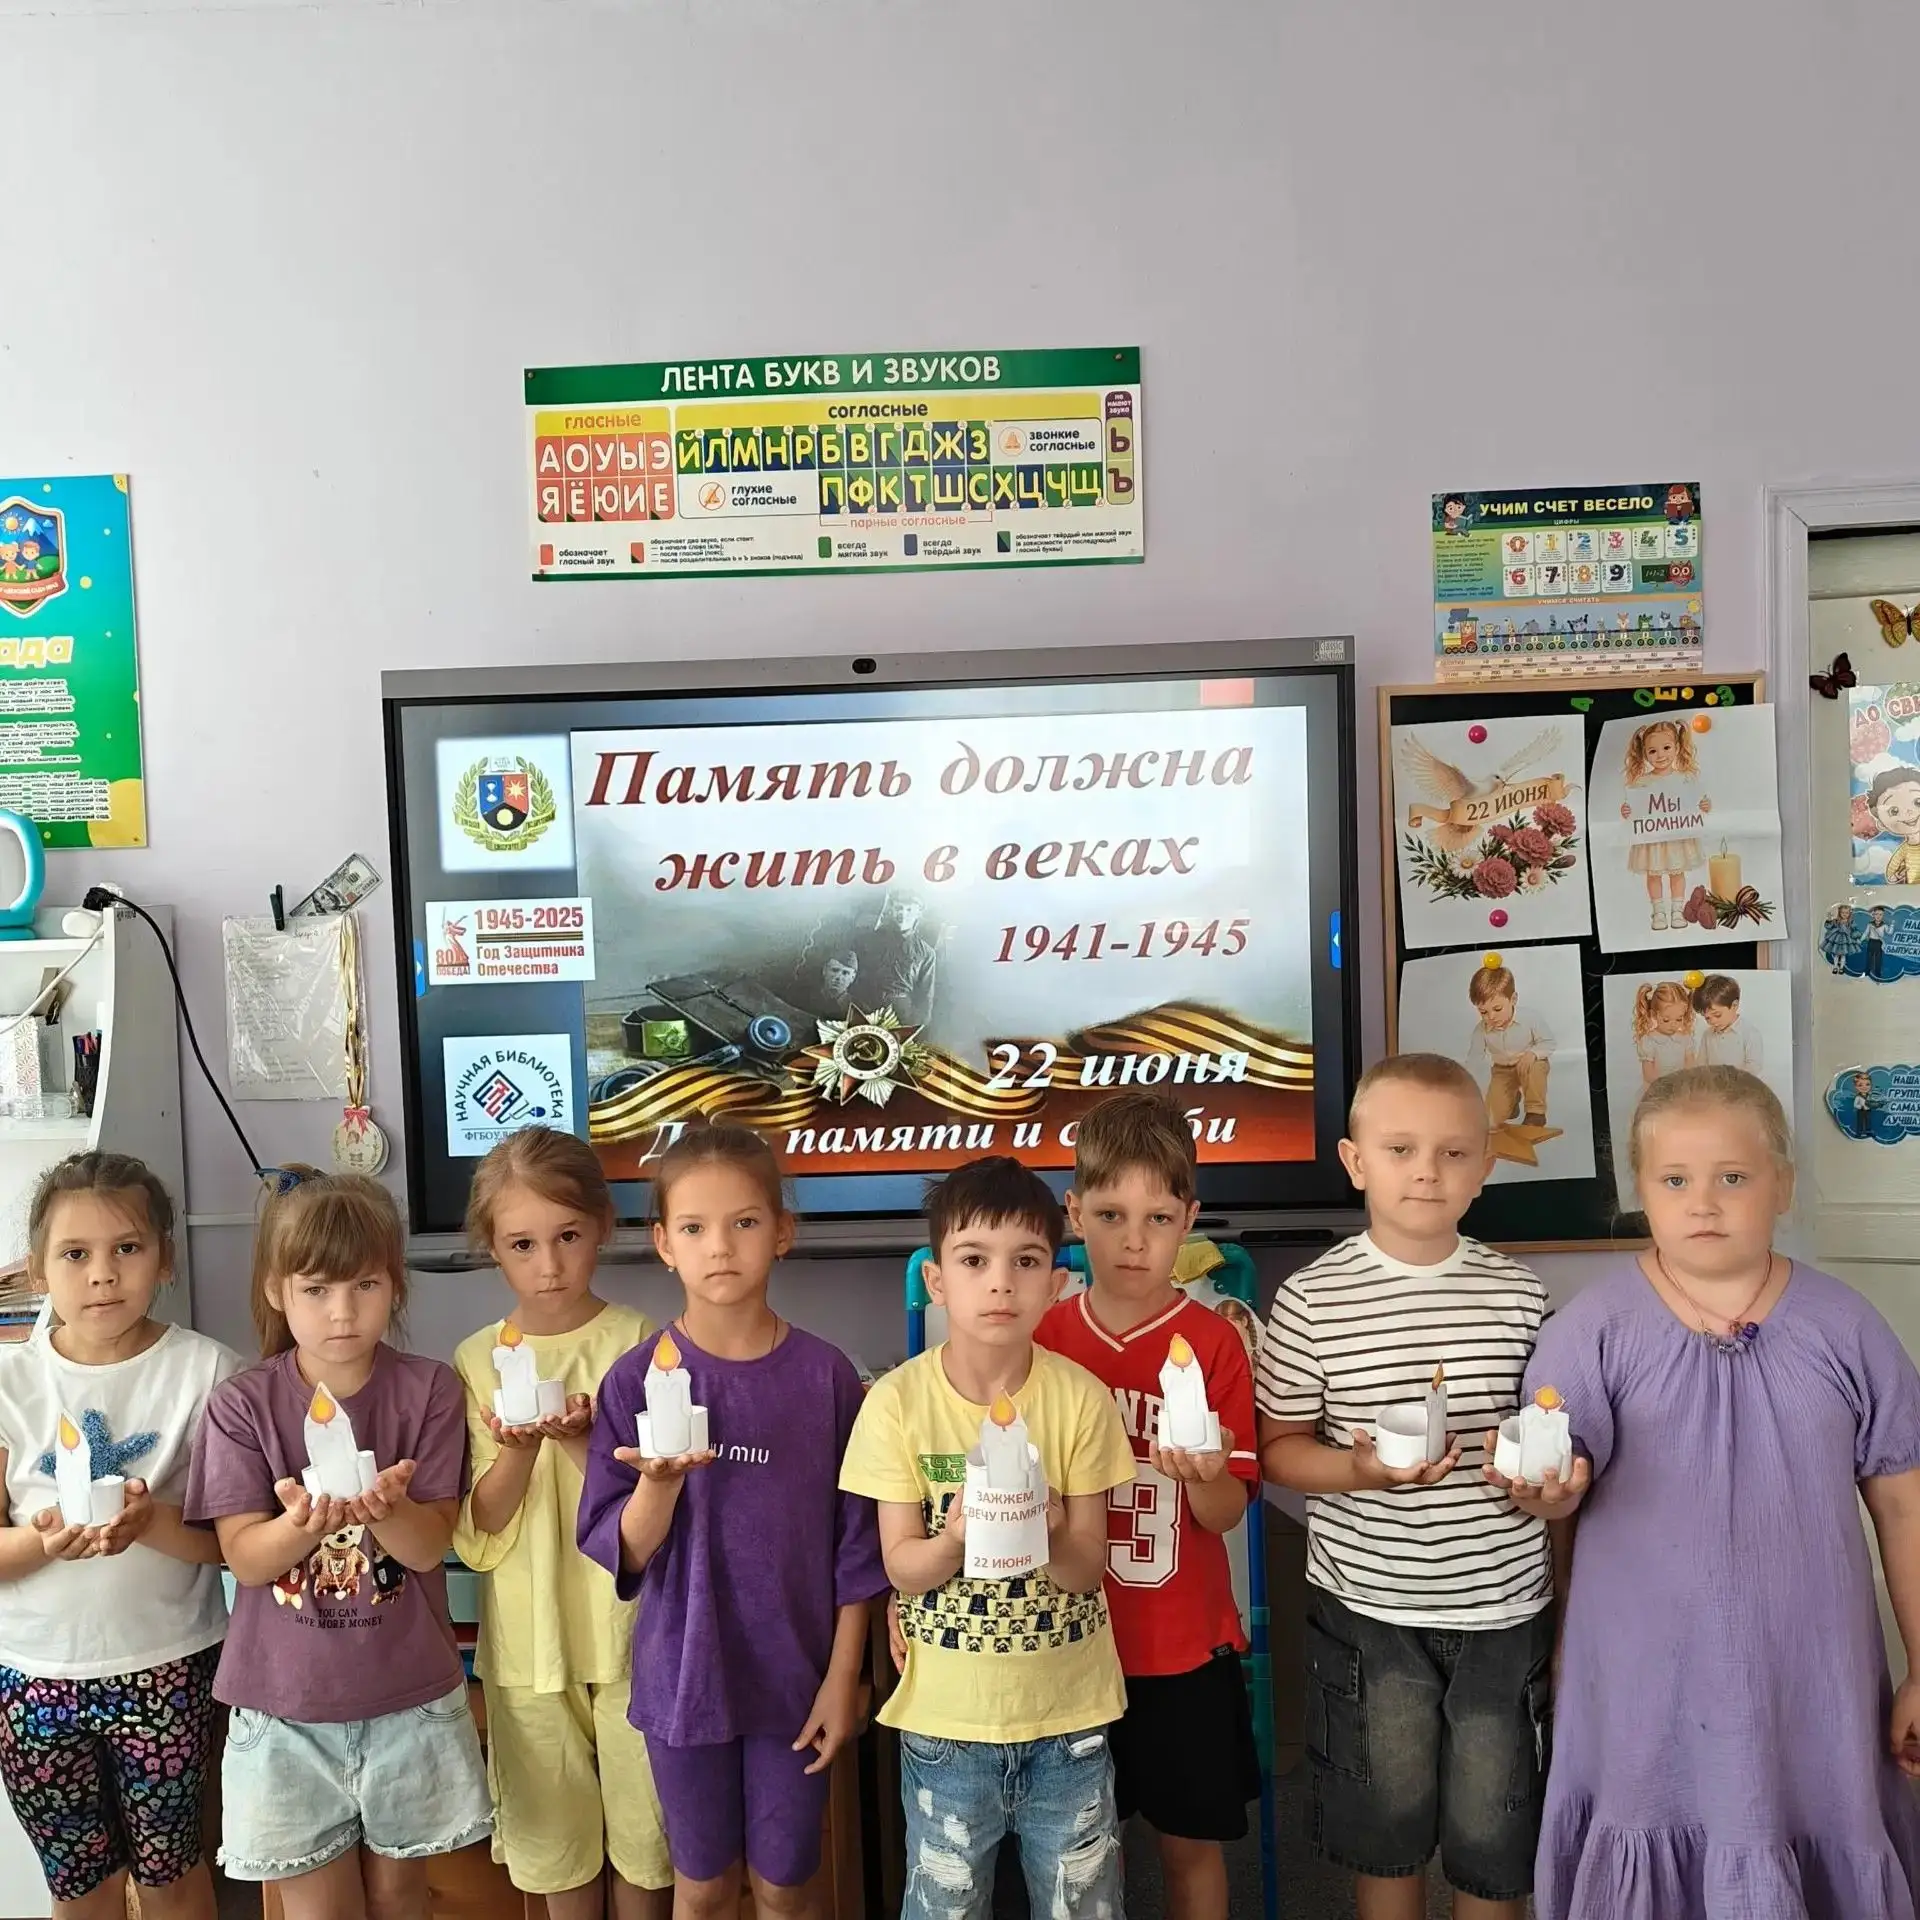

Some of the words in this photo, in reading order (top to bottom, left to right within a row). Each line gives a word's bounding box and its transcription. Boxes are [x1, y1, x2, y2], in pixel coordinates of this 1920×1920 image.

[661, 363, 754, 392] ЛЕНТА
[765, 360, 841, 387] БУКВ
[852, 360, 872, 384] И
[884, 356, 1000, 384] ЗВУКОВ
[829, 402, 928, 418] согласные
[565, 411, 642, 430] гласные
[1029, 430, 1080, 440] звонкие
[1030, 441, 1096, 452] согласные
[732, 484, 773, 495] глухие
[732, 494, 797, 506] согласные
[1479, 502, 1528, 517] УЧИМ
[1533, 500, 1579, 514] СЧЕТ
[1583, 496, 1654, 512] ВЕСЕЛО
[850, 517, 897, 529] парные
[901, 516, 966, 527] согласные
[559, 549, 608, 557] обозначает
[837, 542, 867, 550] всегда
[838, 549, 867, 558] мягкий
[870, 550, 888, 558] звук
[963, 548, 981, 556] звук
[559, 557, 594, 565] гласный
[597, 558, 615, 566] звук
[1856, 706, 1880, 728] ДО
[585, 750, 911, 807] Память
[940, 741, 1254, 795] должна
[1467, 801, 1490, 821] 22
[1497, 784, 1549, 812] ИЮНЯ
[1648, 793, 1681, 814] Мы
[655, 846, 895, 892] жить
[924, 844, 959, 883] в
[985, 835, 1199, 881] веках
[474, 907, 584, 930] 1945-2025
[993, 918, 1250, 964] 1941-1945
[476, 946, 501, 960] Год
[504, 945, 585, 959] Защитника
[477, 963, 559, 977] Отечества
[985, 1042, 1059, 1089] 22
[1079, 1051, 1250, 1087] июня
[455, 1055, 492, 1122] НАУЧНАЯ
[495, 1050, 564, 1119] БИБЛИОТЕКА
[1885, 1115, 1920, 1125] ЛУЧША
[785, 1122, 994, 1154] памяти
[1013, 1122, 1042, 1149] и
[1059, 1106, 1237, 1148] сби
[977, 1490, 1034, 1505] ЗАЖЖЕМ
[1000, 1501, 1049, 1522] ПАМЯТИ
[974, 1556, 989, 1568] 22
[992, 1555, 1032, 1568] ИЮНЯ
[318, 1609, 335, 1618] YOU
[338, 1608, 358, 1617] CAN
[295, 1614, 315, 1627] SAVE
[318, 1619, 346, 1629] MORE
[348, 1615, 383, 1628] MONEY
